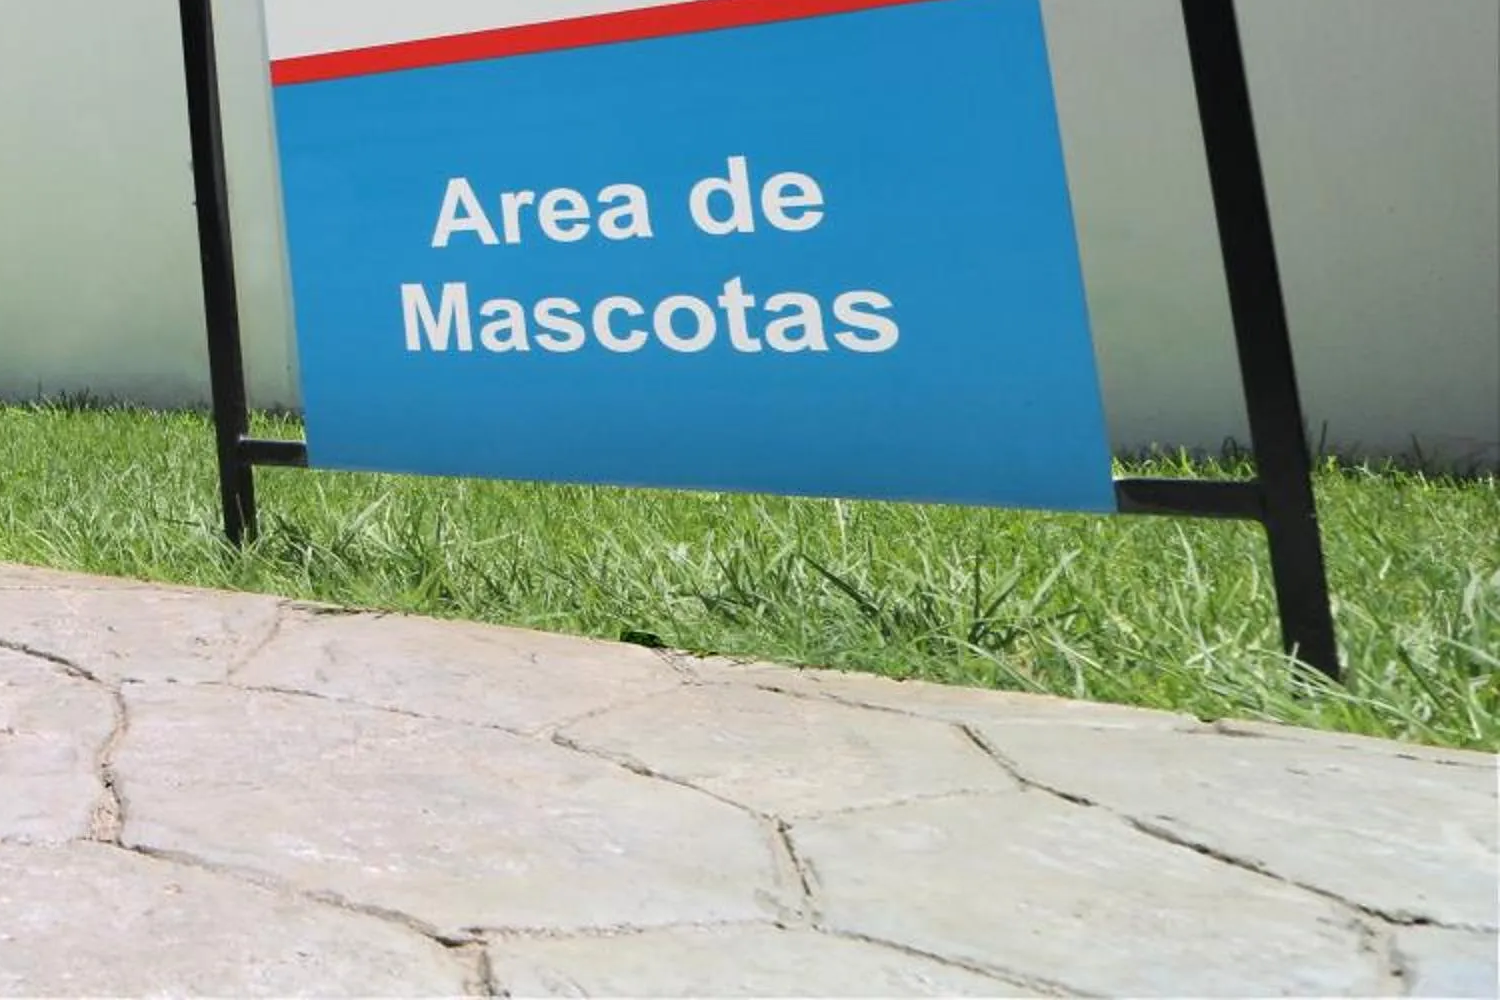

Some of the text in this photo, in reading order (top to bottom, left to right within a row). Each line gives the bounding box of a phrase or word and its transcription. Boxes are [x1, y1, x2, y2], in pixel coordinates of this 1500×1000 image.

[430, 154, 826, 249] Area de
[400, 276, 900, 355] Mascotas
